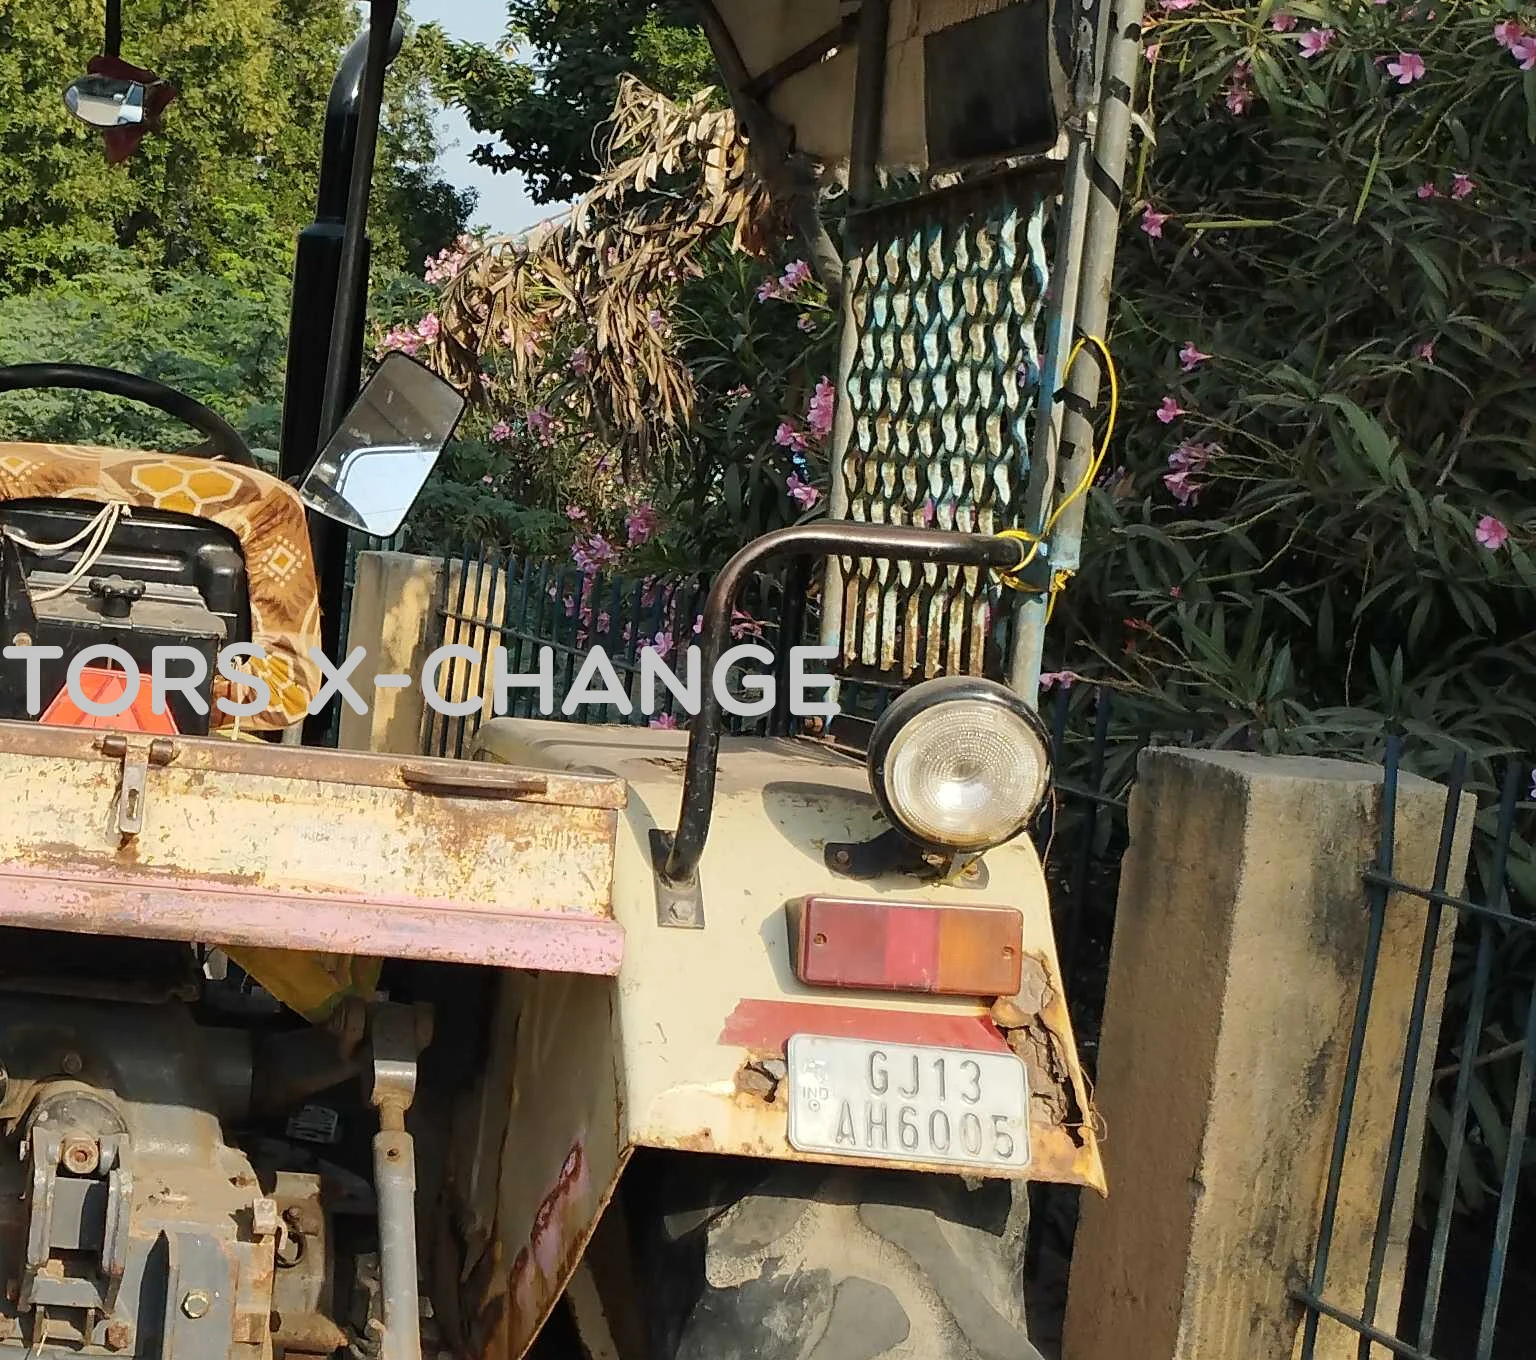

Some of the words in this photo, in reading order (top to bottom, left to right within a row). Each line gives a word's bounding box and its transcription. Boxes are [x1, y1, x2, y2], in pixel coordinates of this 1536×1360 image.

[801, 1086, 829, 1101] IND
[868, 1050, 981, 1105] GJ13
[834, 1099, 1015, 1160] AH6005
